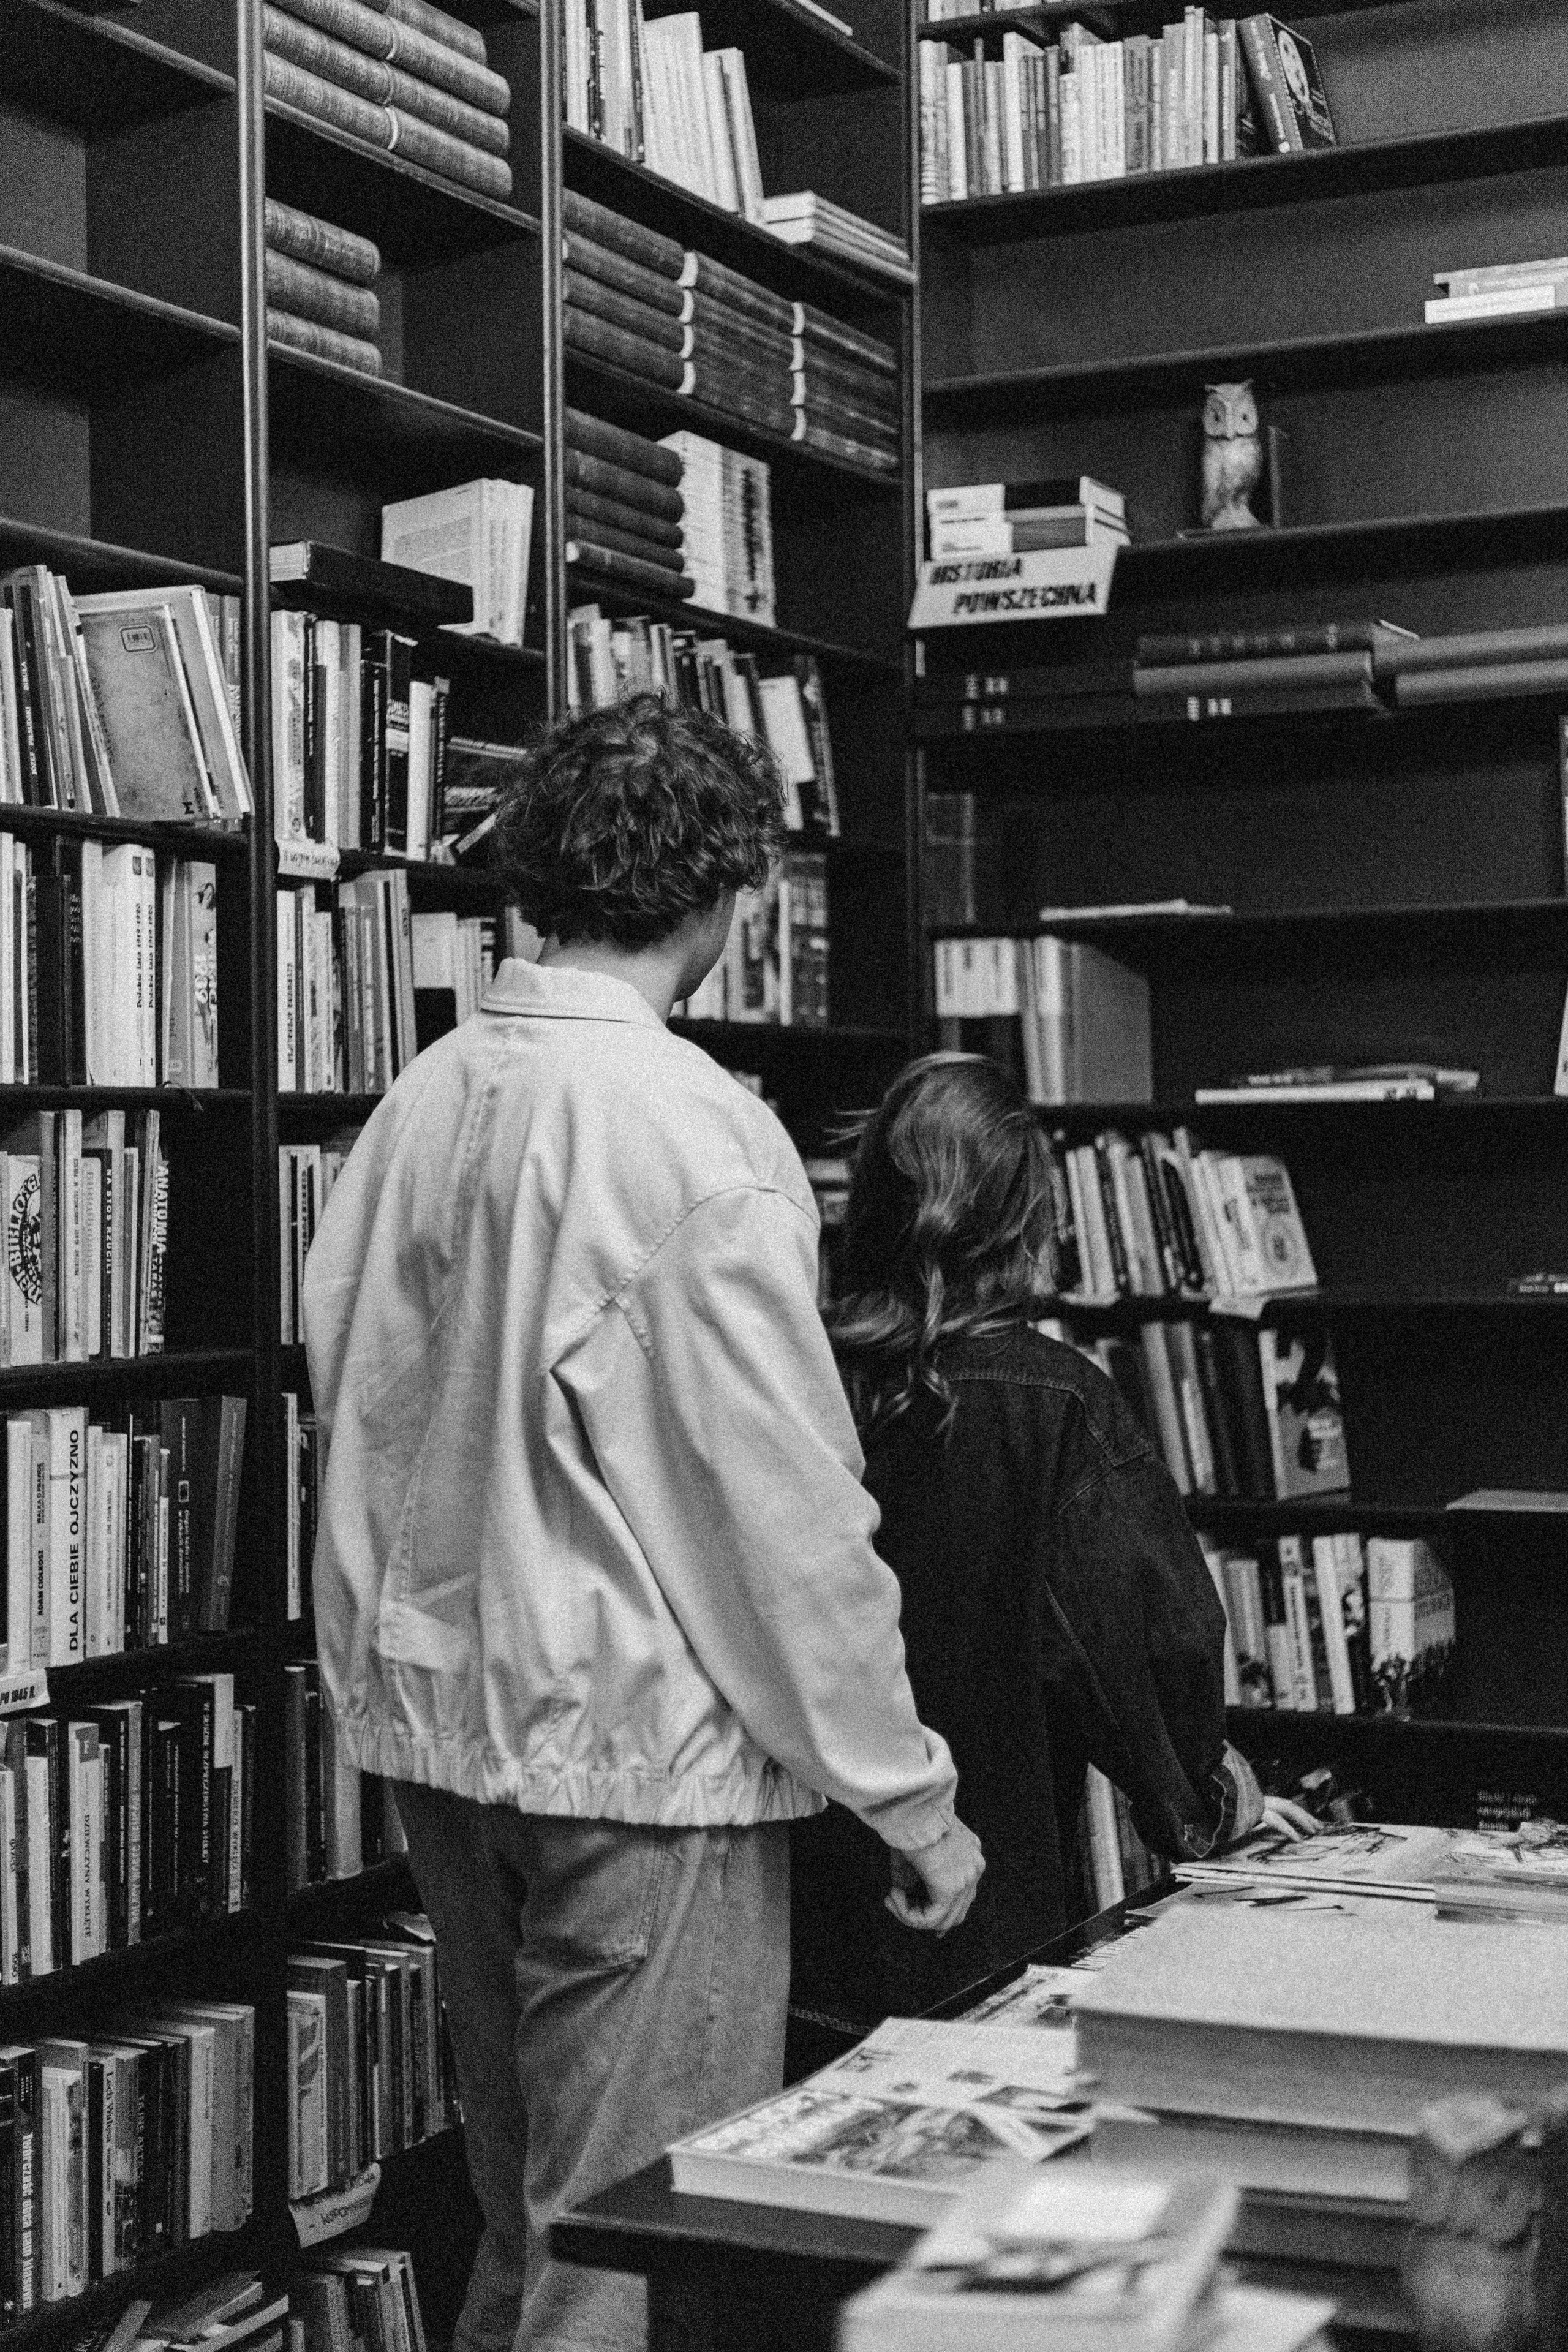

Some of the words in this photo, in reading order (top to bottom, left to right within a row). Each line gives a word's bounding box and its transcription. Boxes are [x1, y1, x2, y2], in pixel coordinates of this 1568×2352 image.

[929, 557, 1022, 586] HISTORIA
[952, 582, 1097, 615] POWSZECHNA
[106, 1169, 112, 1185] NA
[155, 1165, 170, 1254] ANATOMIA
[69, 1430, 80, 1536] OJCZYZNO
[69, 1544, 79, 1605] CIEBIE
[69, 1611, 79, 1651] DLA
[105, 2071, 114, 2100] Lech
[22, 2198, 34, 2228] obca
[22, 2230, 32, 2257] nam
[22, 2258, 34, 2309] klasowo
